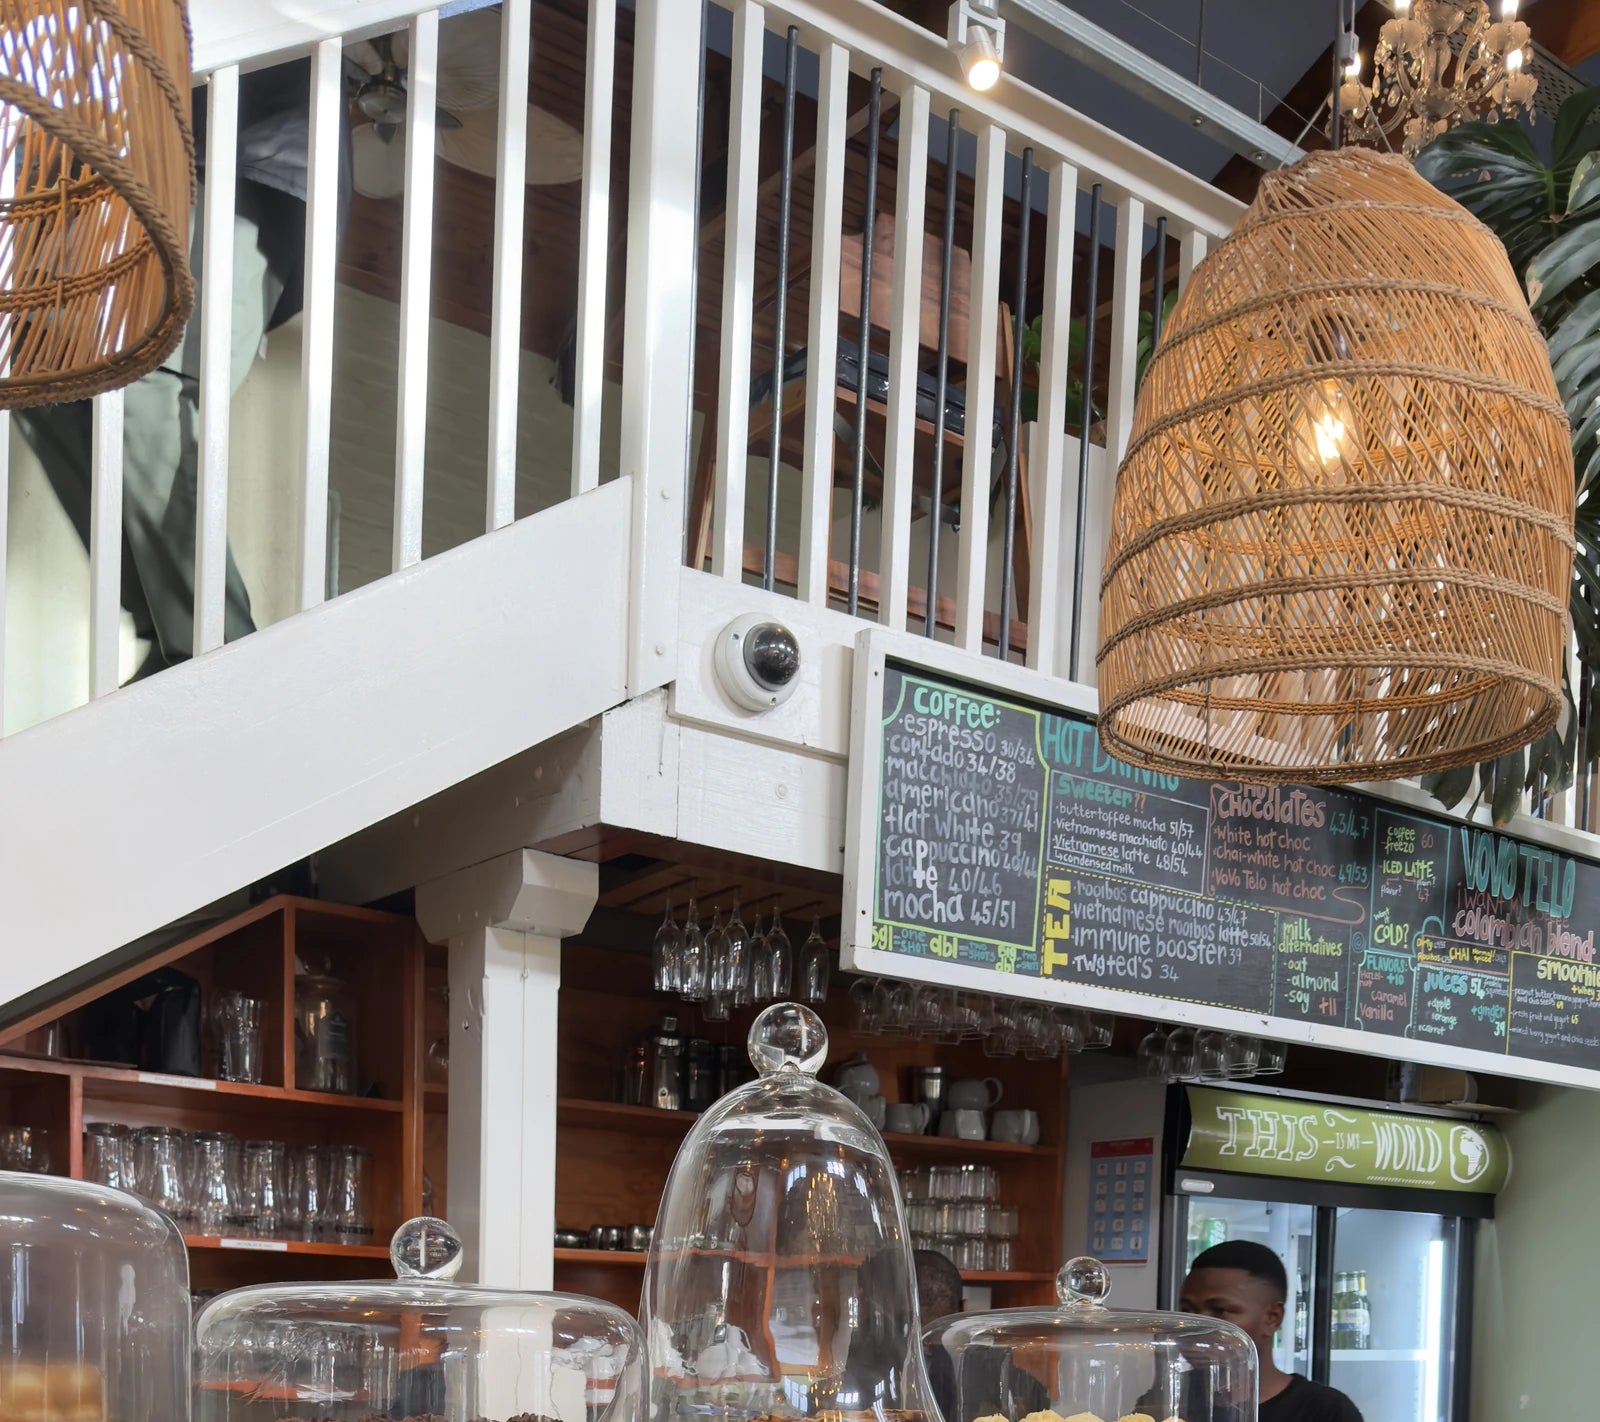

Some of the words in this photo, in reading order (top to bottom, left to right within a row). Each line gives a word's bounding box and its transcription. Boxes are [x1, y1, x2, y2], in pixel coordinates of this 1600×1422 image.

[904, 714, 996, 753] espresso
[1000, 739, 1036, 769] 30/34
[1043, 714, 1092, 768] HOT
[890, 734, 964, 769] cortado
[967, 753, 1016, 783] 34/38
[887, 756, 992, 796] macchiato
[886, 779, 999, 817] americano
[1001, 804, 1038, 832] 37/41
[885, 802, 931, 839] flat
[934, 811, 995, 848] white
[1000, 830, 1022, 855] 39
[1056, 818, 1117, 841] Vietnamese
[1119, 831, 1168, 851] macchiato
[1172, 840, 1203, 859] 40/44
[1133, 817, 1165, 832] mocha
[1170, 818, 1194, 840] 51/57
[1329, 808, 1369, 839] 43/47
[1388, 826, 1416, 842] coffee
[1421, 833, 1434, 848] 60
[886, 834, 1000, 867] cappuccino
[1256, 827, 1277, 849] hot
[1279, 829, 1311, 851] choc
[1384, 836, 1415, 854] freezo
[1055, 834, 1120, 859] Vietnamese
[1122, 845, 1150, 864] latte
[1156, 855, 1188, 876] 48/54
[1063, 851, 1111, 872] condensed
[1113, 861, 1135, 875] milk
[1284, 854, 1304, 872] hot
[1306, 860, 1336, 878] choc
[1338, 862, 1368, 884] 49/53
[1382, 859, 1402, 875] ICED
[1404, 859, 1434, 879] LATTE
[886, 856, 938, 890] latte
[949, 866, 1003, 897] 40/46
[1242, 870, 1267, 890] Telo
[1272, 875, 1290, 897] hot
[1293, 880, 1327, 900] choc
[1461, 826, 1517, 900] VOVO
[1520, 842, 1576, 918] TELO
[884, 888, 964, 923] mocha
[970, 898, 1016, 928] 45/51
[1077, 880, 1127, 901] rooibos
[1130, 888, 1214, 920] cappuccino
[1217, 905, 1247, 927] 43/47
[1044, 879, 1071, 975] TEA
[1074, 902, 1164, 932] vietnamese
[1169, 918, 1215, 941] rooibos
[1219, 925, 1248, 947] latte
[1283, 918, 1311, 941] milk
[1374, 923, 1409, 949] COLD?
[930, 934, 958, 959] dbl
[1074, 927, 1150, 954] immune
[1156, 935, 1228, 965] booster
[1228, 948, 1241, 966] 39
[1278, 936, 1343, 956] alternatives
[1449, 947, 1469, 961] CHAI
[1160, 965, 1180, 981] 34
[1386, 974, 1405, 986] +10
[1371, 990, 1407, 1008] caramel
[1470, 978, 1485, 999] 54
[1494, 1021, 1505, 1036] 39
[1216, 1106, 1319, 1161] THIS
[1336, 1132, 1344, 1149] IS
[1346, 1133, 1360, 1150] MY
[1372, 1121, 1442, 1173] WORLD
